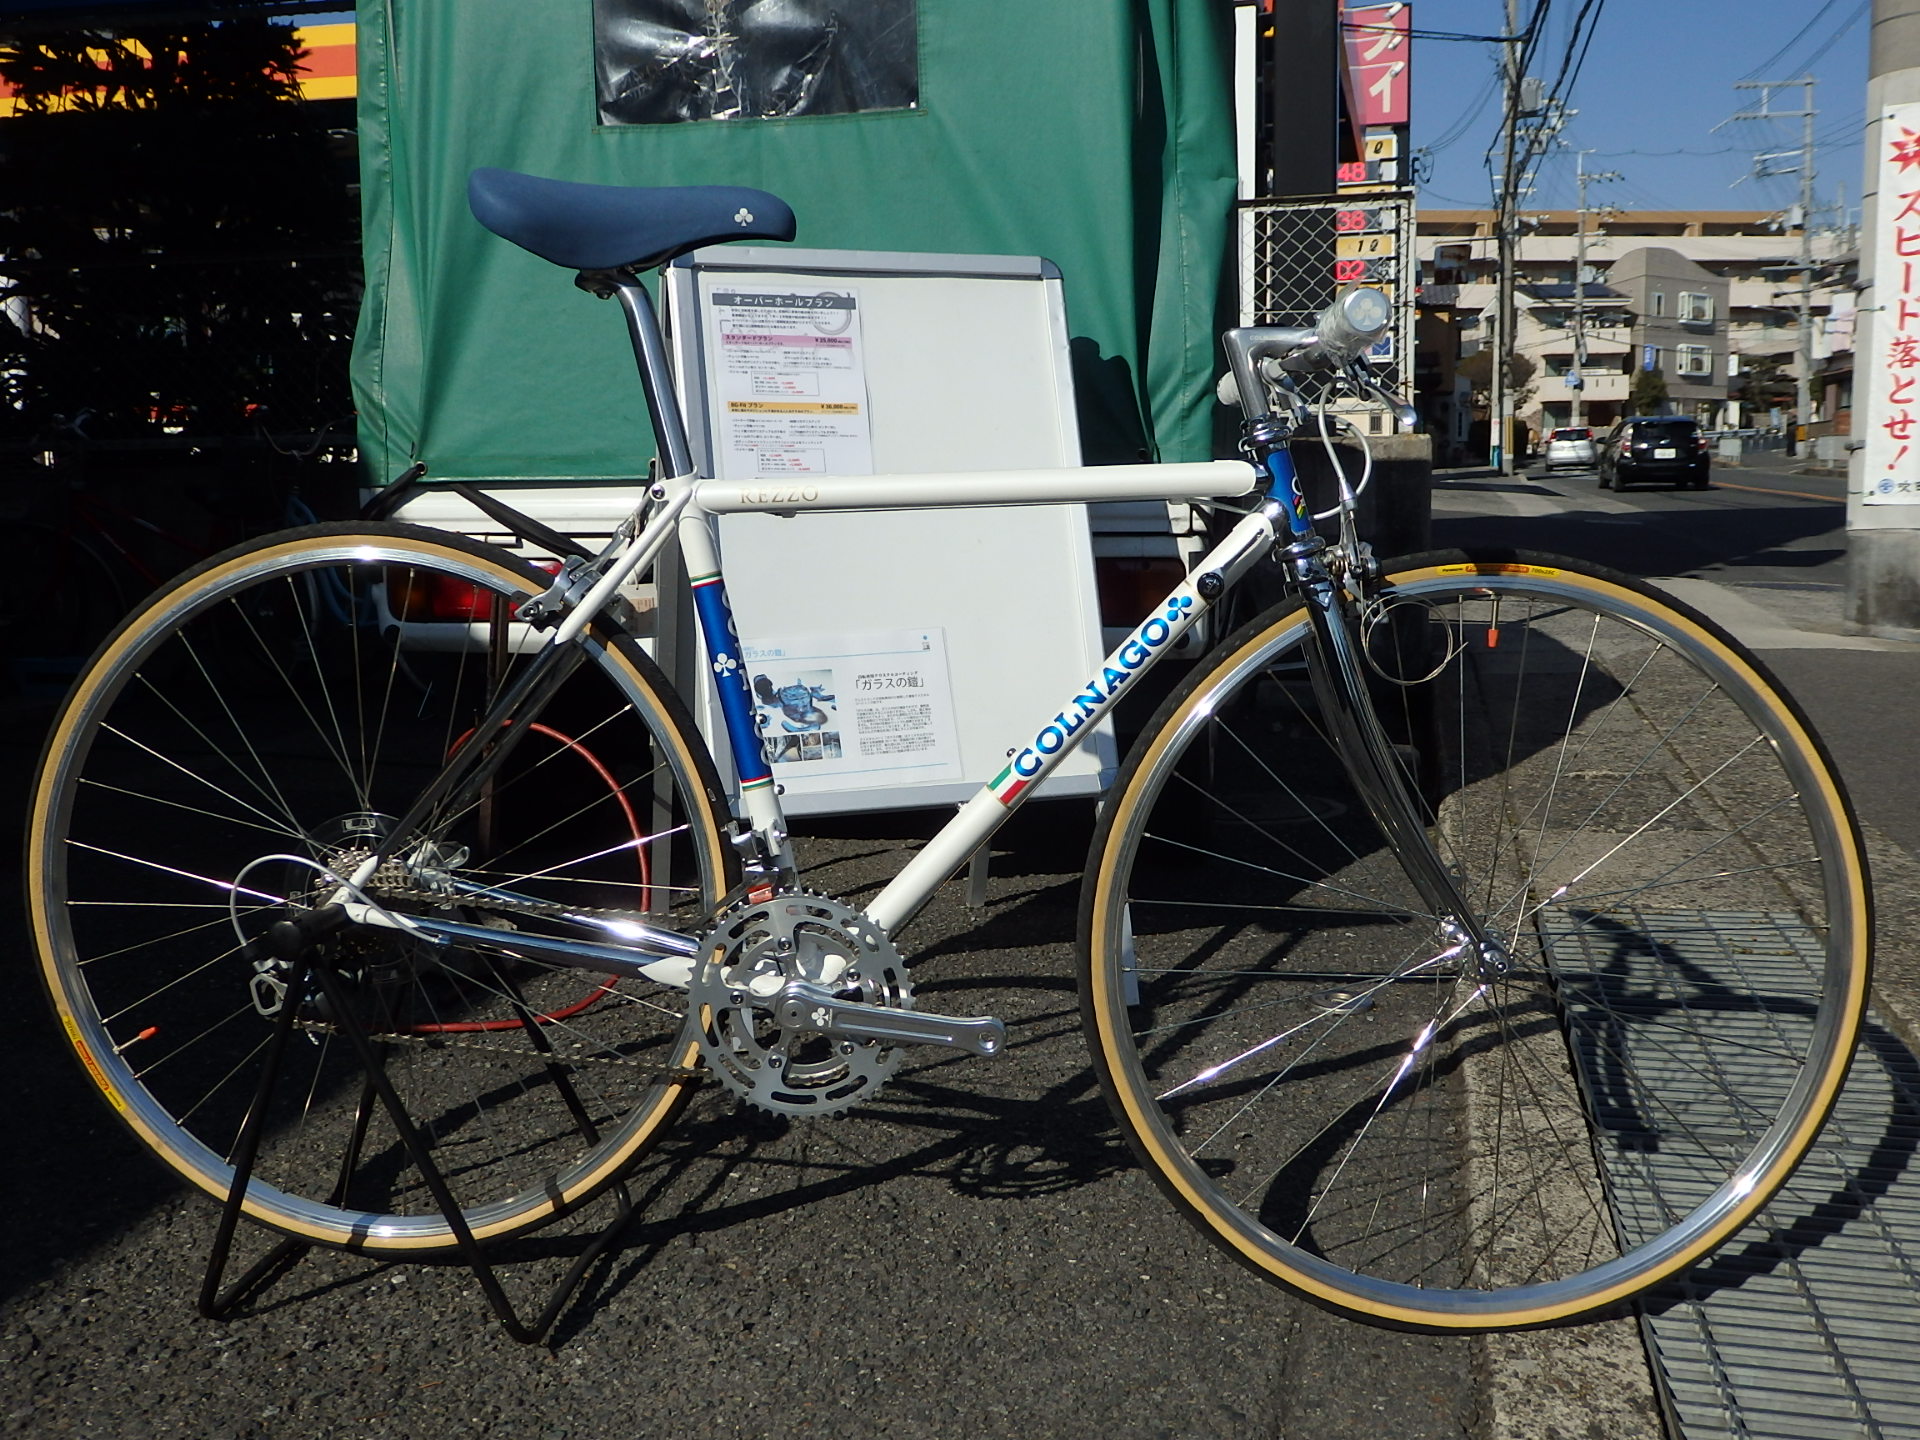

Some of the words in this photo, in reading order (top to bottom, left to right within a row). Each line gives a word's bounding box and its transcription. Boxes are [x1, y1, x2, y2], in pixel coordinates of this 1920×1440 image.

[733, 295, 833, 308] オーバーホールプラン
[741, 486, 819, 504] REZZO
[1014, 617, 1169, 777] COLNAGO
